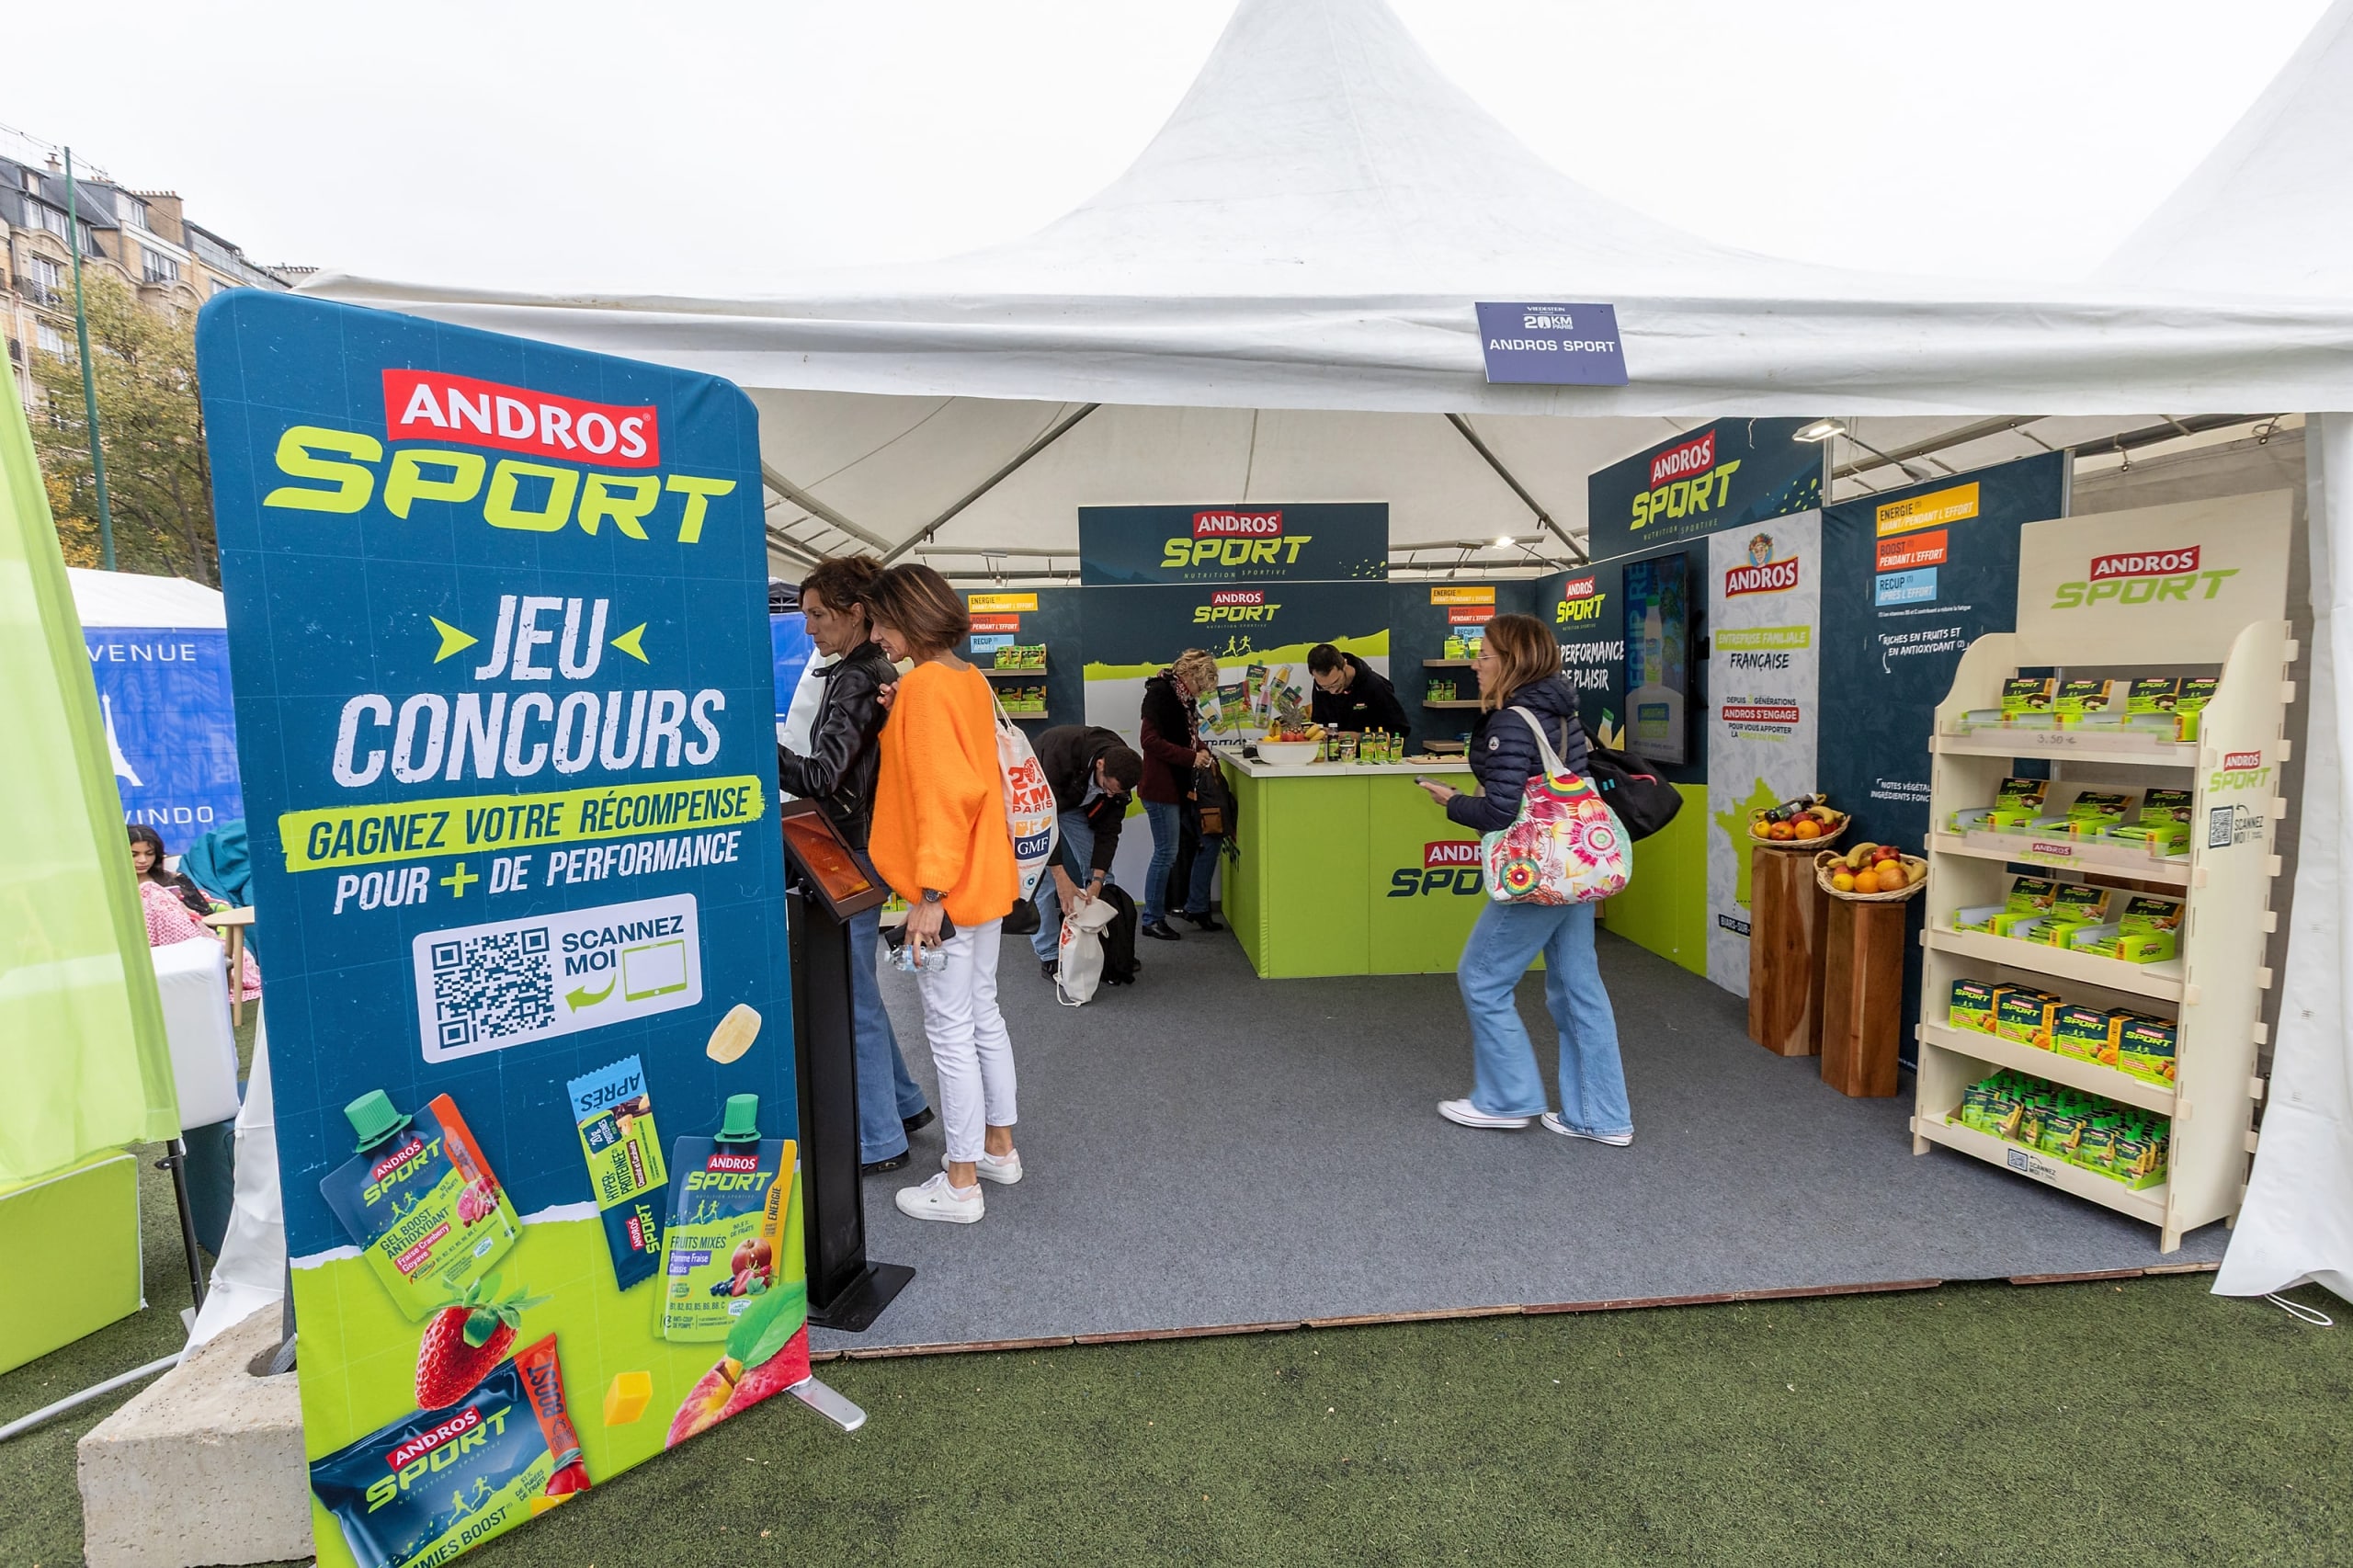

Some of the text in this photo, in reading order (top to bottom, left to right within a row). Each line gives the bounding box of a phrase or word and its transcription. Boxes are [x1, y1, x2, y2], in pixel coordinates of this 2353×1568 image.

[1524, 316, 1573, 329] 20 KM
[1489, 339, 1615, 352] ANDROS SPORT
[400, 384, 646, 458] ANDROS
[1652, 439, 1711, 483] ANDROS
[263, 426, 736, 543] SPORT
[1630, 460, 1741, 530] SPORT
[1881, 504, 1913, 521] ENERGIE
[1198, 516, 1278, 532] ANDROS
[1643, 517, 1718, 541] NUTRITION SPORTIVE
[1160, 536, 1313, 567] SPORT
[1880, 548, 1944, 567] PENDANT L'EFFORT
[1881, 541, 1905, 556] BOOST
[2094, 551, 2193, 577] ANDROS
[1727, 562, 1795, 594] ANDROS
[1880, 577, 1905, 590] RECUP
[2051, 568, 2240, 608] SPORT
[1214, 593, 1261, 604] ANDROS
[1566, 580, 1594, 597] ANDROS
[971, 597, 995, 605] ENERGIE
[1556, 594, 1606, 624] SPORT
[1192, 604, 1281, 623] SPORT
[475, 596, 609, 680] JEU
[1719, 631, 1806, 645] ENTREPRISE FAMILIALE
[1882, 627, 1961, 645] RICHES EN FRUITS ET
[1561, 641, 1625, 665] PERFORMANCE
[1888, 648, 1899, 656] EN
[1900, 641, 1956, 656] ANTIOXYDANT
[1730, 653, 1790, 672] FRANÇAISE
[1574, 668, 1609, 691] PLAISIR
[1726, 696, 1746, 704] DEPUIS
[1754, 696, 1796, 706] GÉNÉRATIONS
[1724, 709, 1797, 721] ANDROS S'ENGAGE
[333, 689, 725, 787] CONCOURS
[1760, 725, 1792, 733] APPORTER
[2037, 733, 2063, 744] 3.50
[2225, 754, 2259, 767] ANDROS
[1881, 781, 1902, 790] NOTES
[2209, 767, 2271, 792] SPORT
[1012, 784, 1051, 805] KM
[1870, 790, 1910, 801] INGRÉDIENTS
[1012, 799, 1053, 813] PARIS
[307, 786, 751, 860] GAGNEZ VOTRE RÉCOMPENSE
[2234, 815, 2264, 831] SCANNEZ
[1017, 836, 1049, 856] GMF
[2034, 844, 2070, 855] ANDROS
[333, 866, 429, 915] POUR
[489, 856, 531, 894] DE
[546, 831, 741, 887] PERFORMANCE
[562, 915, 684, 953] SCANNEZ
[564, 949, 616, 977] MOI
[1955, 988, 1990, 1002] SPORT
[2001, 1003, 2040, 1017] SPORT
[2063, 1016, 2107, 1030] SPORT
[2125, 1030, 2172, 1047] SPORT
[580, 1073, 641, 1112] APRÈS
[377, 1141, 421, 1178] ANDROS
[710, 1157, 756, 1170] ANDROS
[2029, 1161, 2057, 1176] SCANNEZ
[363, 1137, 441, 1208] SPORT
[685, 1171, 772, 1191] SPORT
[601, 1170, 620, 1202] HYPER-
[767, 1186, 781, 1221] ENERGIE
[380, 1208, 433, 1252] GEL BOOST
[387, 1206, 449, 1260] ANTIOXYDANT
[628, 1218, 643, 1247] ANDROS
[635, 1203, 661, 1255] SPORT
[396, 1247, 420, 1267] Fraise
[418, 1224, 449, 1252] Cranberry
[671, 1233, 727, 1249] FRUITS MIXÉS
[402, 1251, 429, 1273] Goyave
[670, 1254, 709, 1264] Pomme Fraise
[669, 1265, 688, 1274] Cassis
[527, 1354, 565, 1419] BOOST
[395, 1410, 478, 1466] ANDROS
[366, 1405, 512, 1514] SPORT
[398, 1440, 501, 1506] NUTRITION SPORTIVE
[460, 1506, 506, 1546] BOOST
